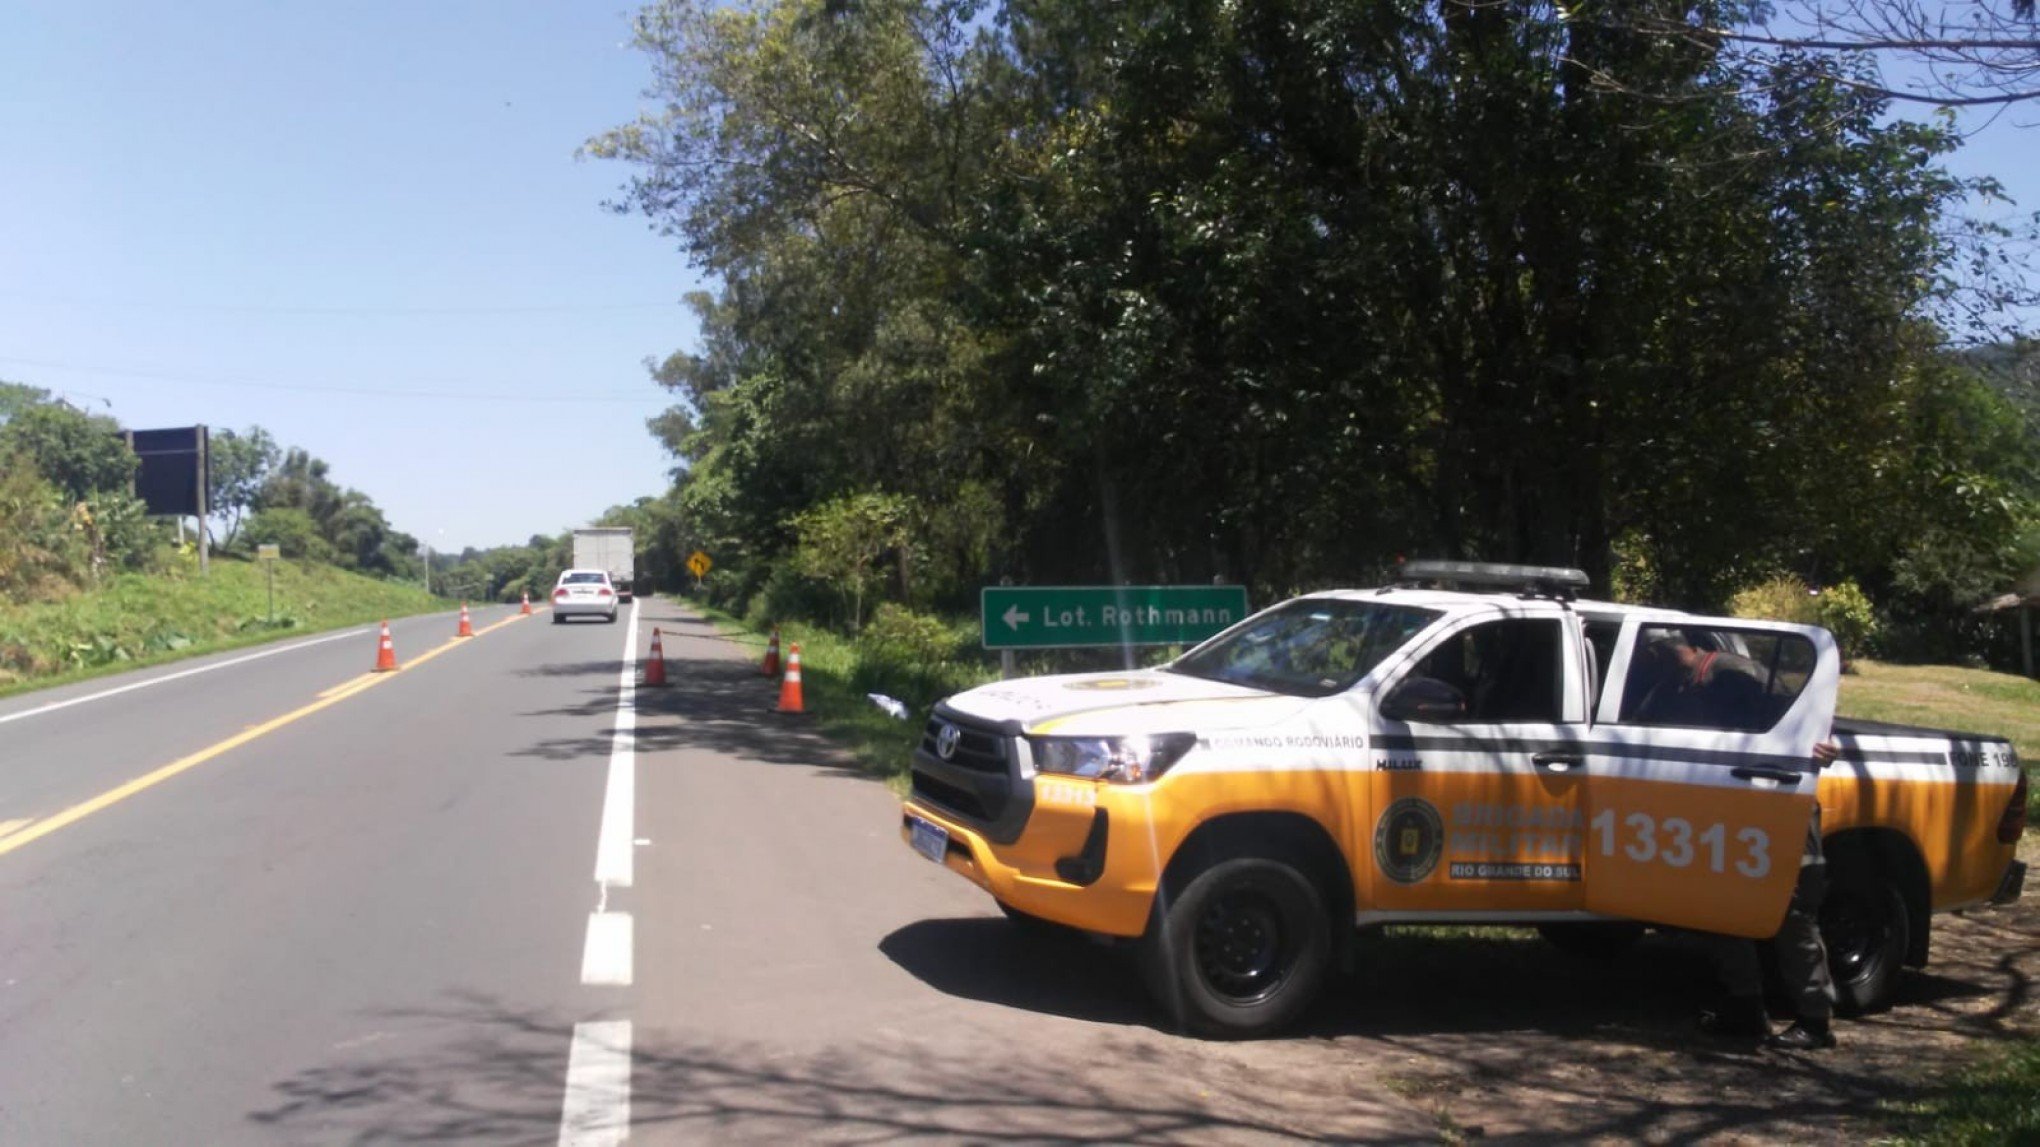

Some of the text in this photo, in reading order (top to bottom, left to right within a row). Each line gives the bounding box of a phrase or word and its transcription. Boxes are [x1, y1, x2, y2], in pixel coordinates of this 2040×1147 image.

[1043, 605, 1231, 627] Lot. Rothmann
[1452, 802, 1584, 828] BRIGADA
[1590, 808, 1772, 878] 13313
[1451, 864, 1579, 878] RIO GRANDE DO SUL
